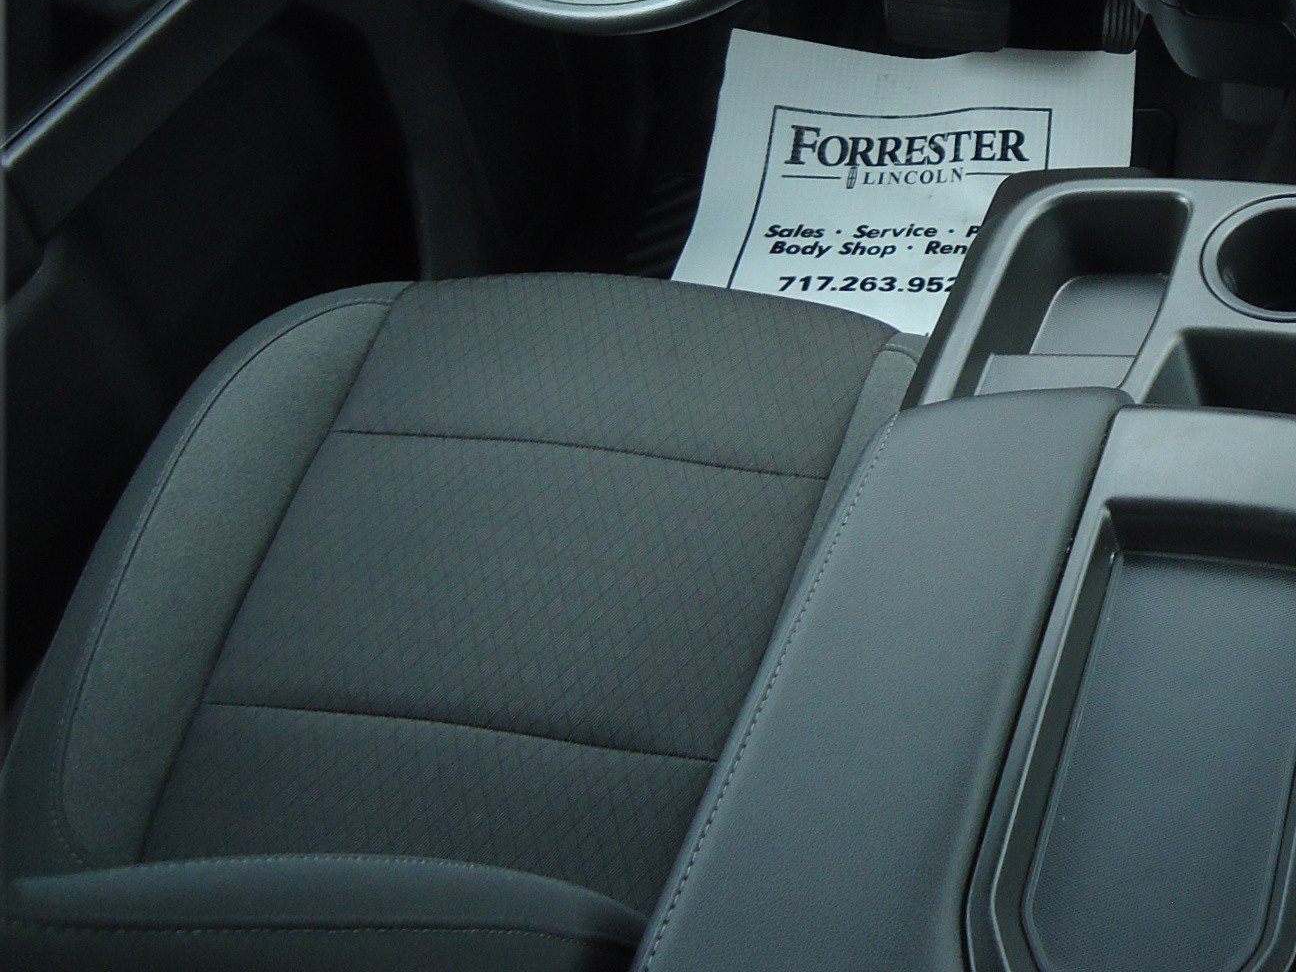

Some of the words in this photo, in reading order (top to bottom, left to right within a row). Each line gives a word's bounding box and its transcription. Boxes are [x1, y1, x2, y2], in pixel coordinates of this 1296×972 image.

[784, 125, 1029, 167] FORRESTER
[863, 167, 964, 185] LINCOLN
[764, 224, 825, 238] Sales
[853, 224, 937, 239] Service
[769, 241, 832, 258] Body
[839, 241, 897, 258] Shop
[925, 241, 968, 255] Ren
